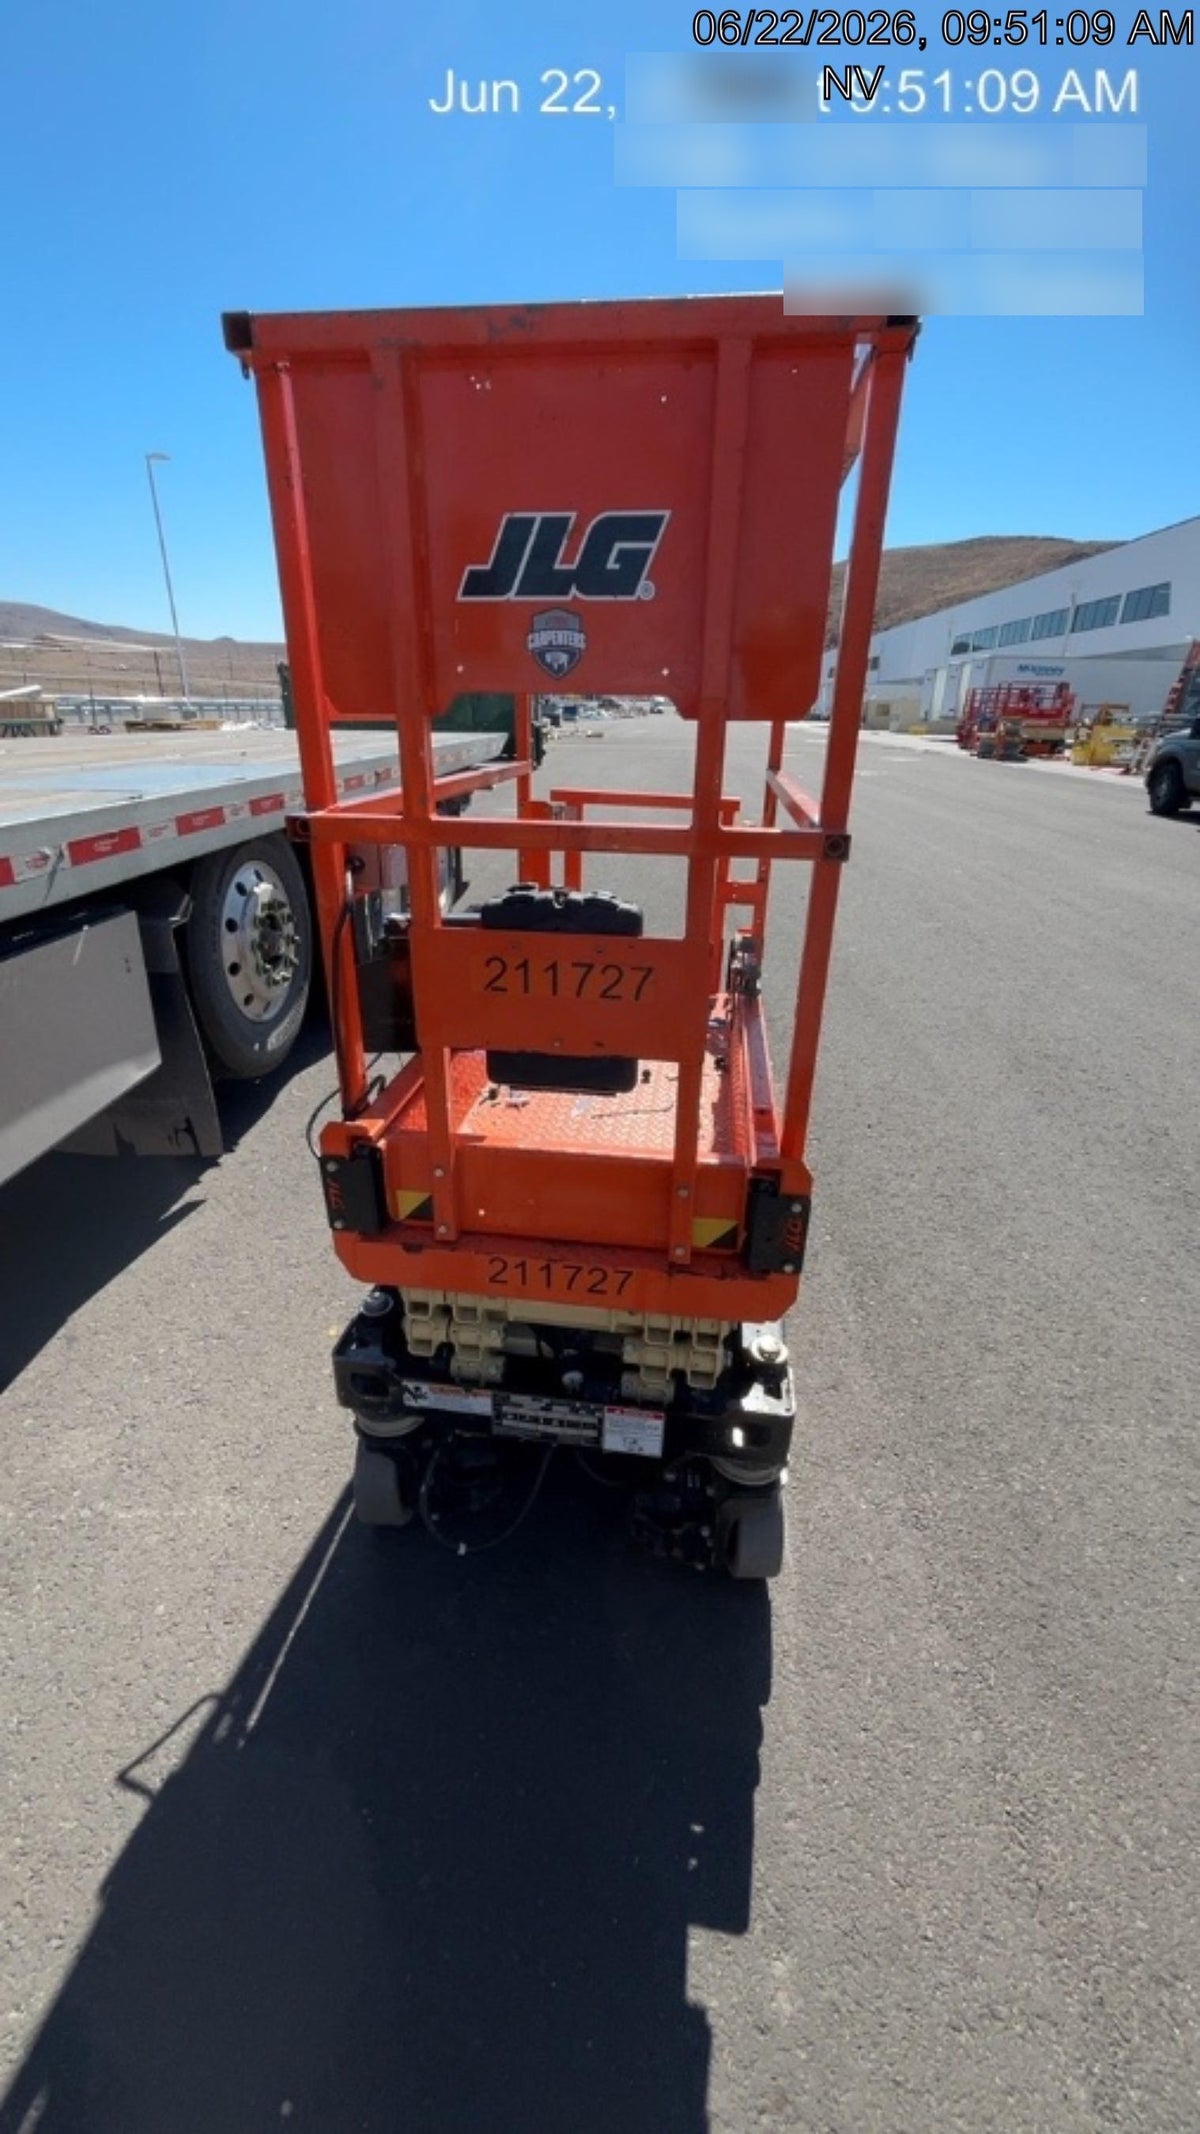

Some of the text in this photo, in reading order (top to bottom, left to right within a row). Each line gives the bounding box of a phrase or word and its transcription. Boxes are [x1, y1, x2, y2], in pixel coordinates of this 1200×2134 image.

[457, 509, 671, 602] JLG
[484, 956, 655, 1002] 211727
[488, 1256, 634, 1295] 211727
